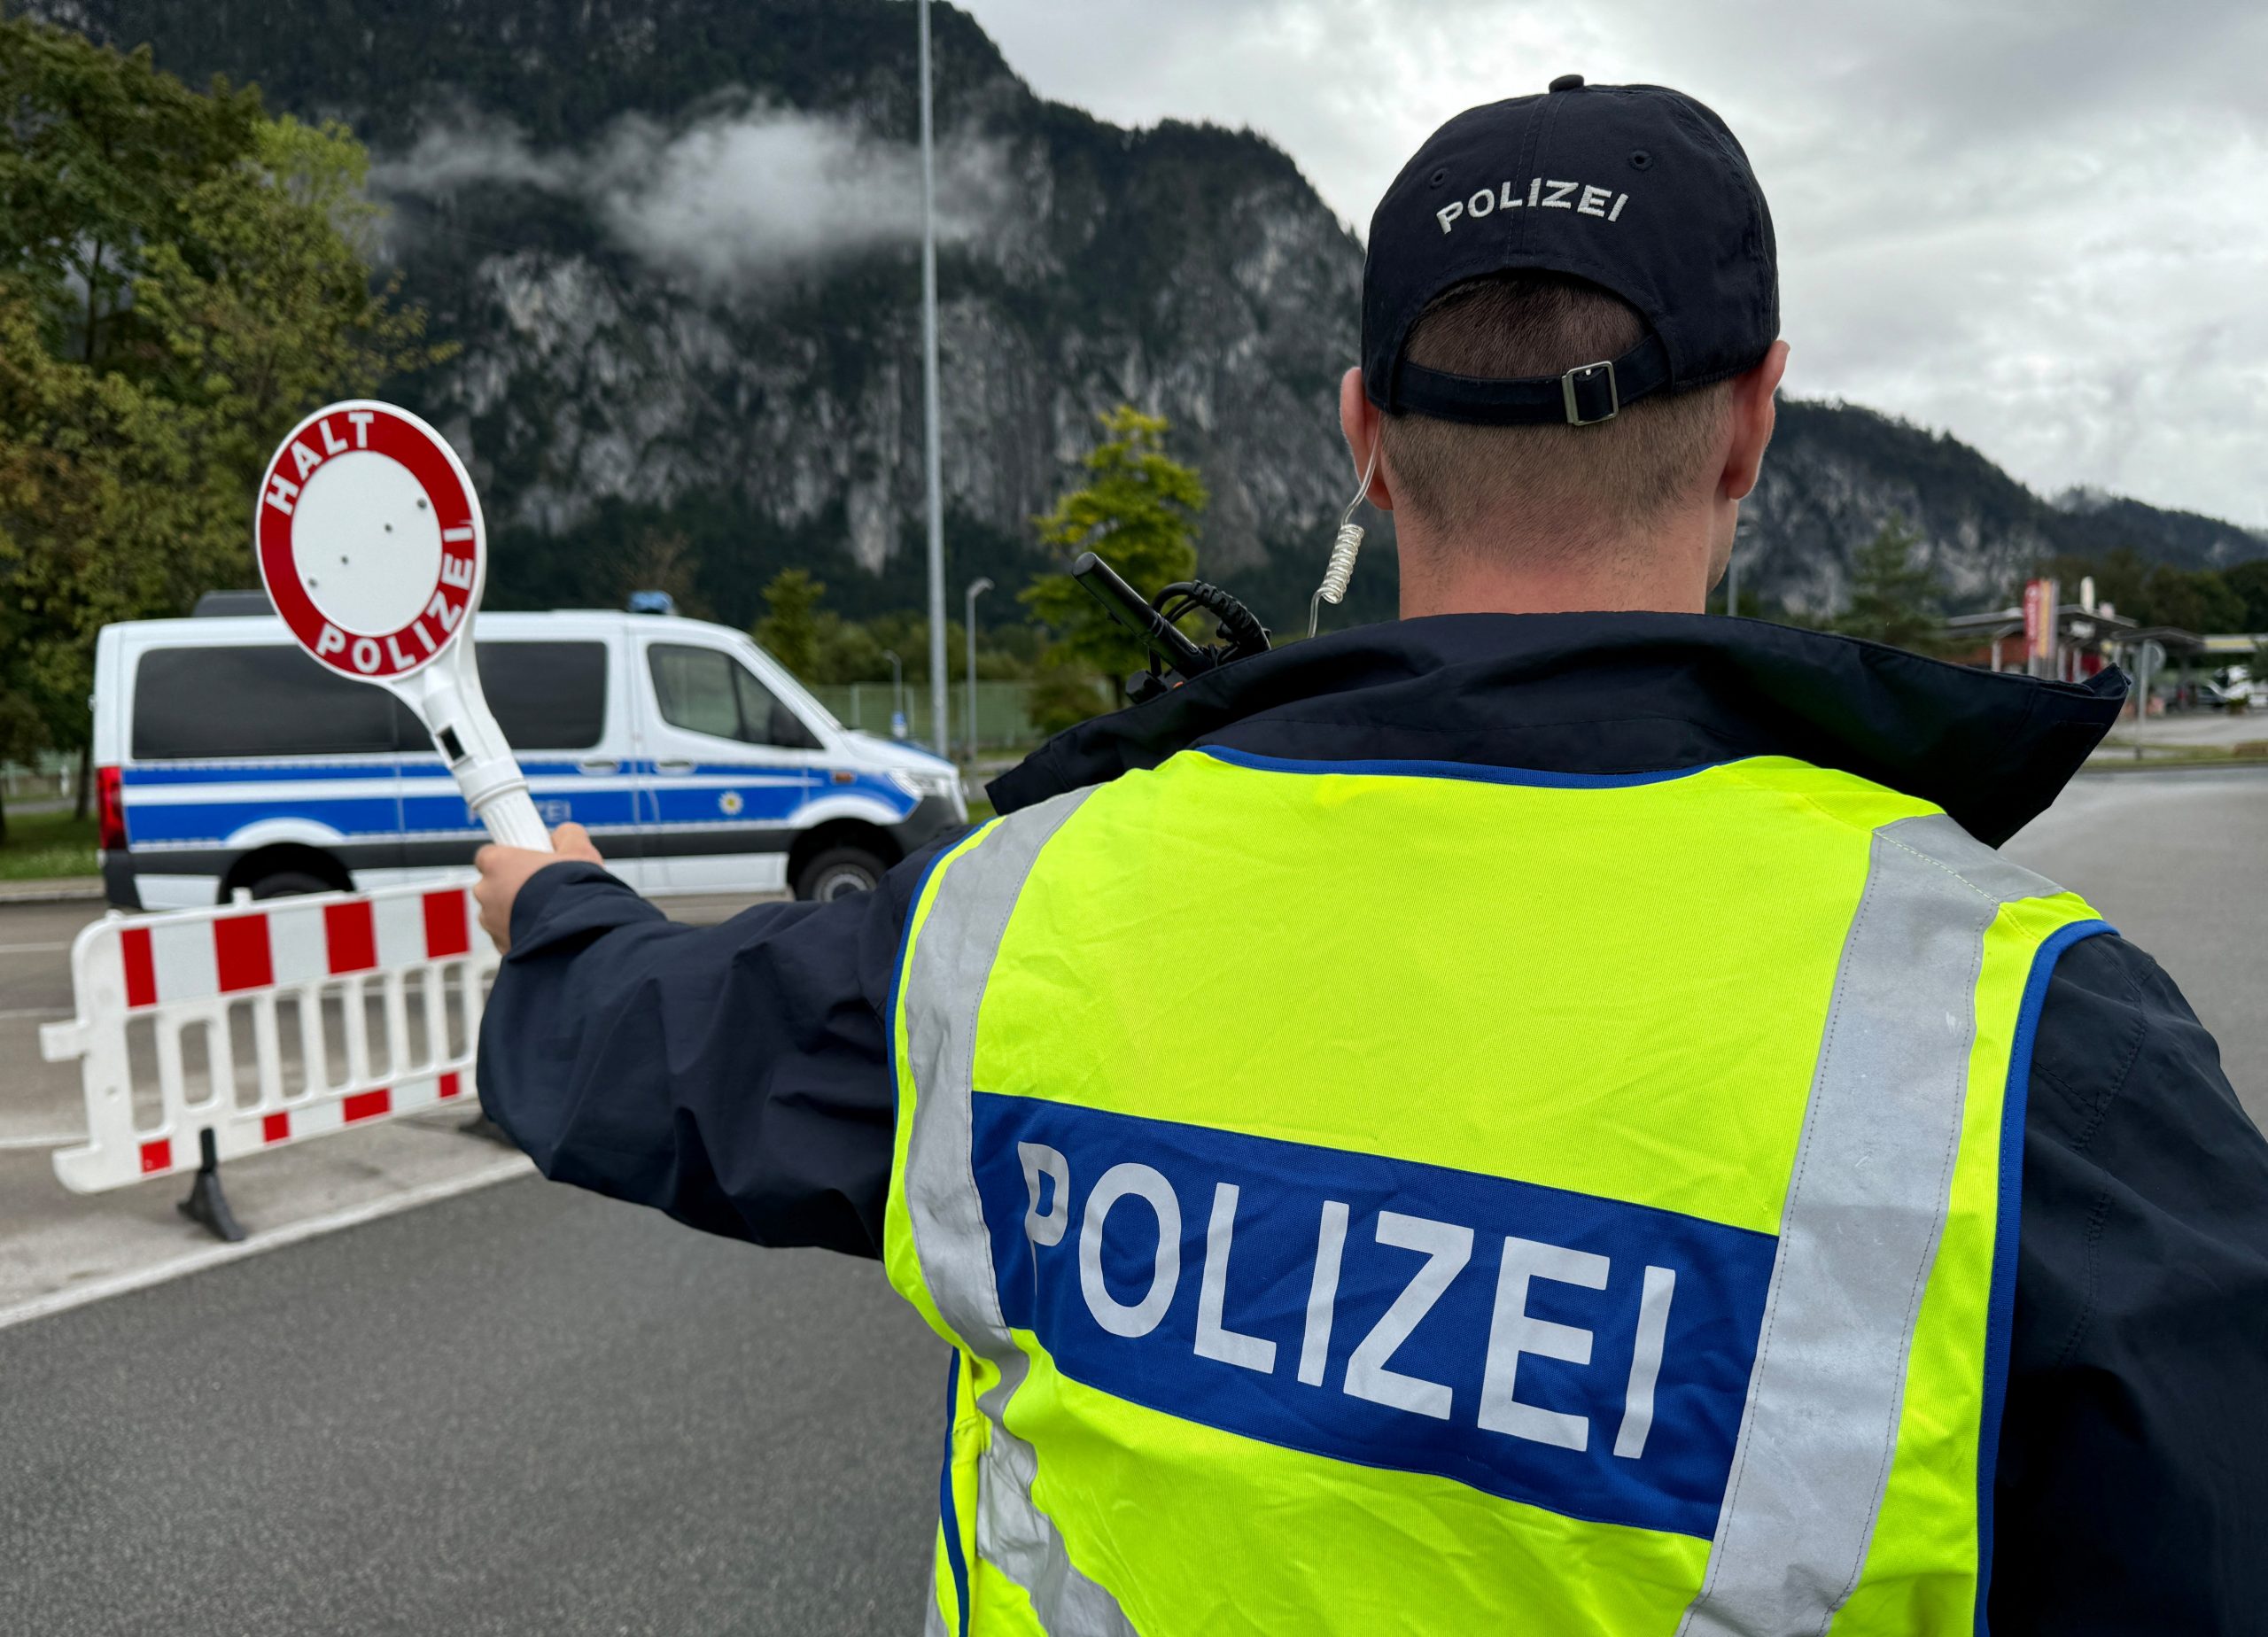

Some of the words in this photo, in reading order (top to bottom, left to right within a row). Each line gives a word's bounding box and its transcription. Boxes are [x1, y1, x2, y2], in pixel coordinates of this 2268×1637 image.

[1436, 177, 1629, 235] POLIZEI
[266, 412, 374, 516] HALT
[315, 526, 475, 674] POLIZEI
[1016, 1141, 1676, 1460] POLIZEI
